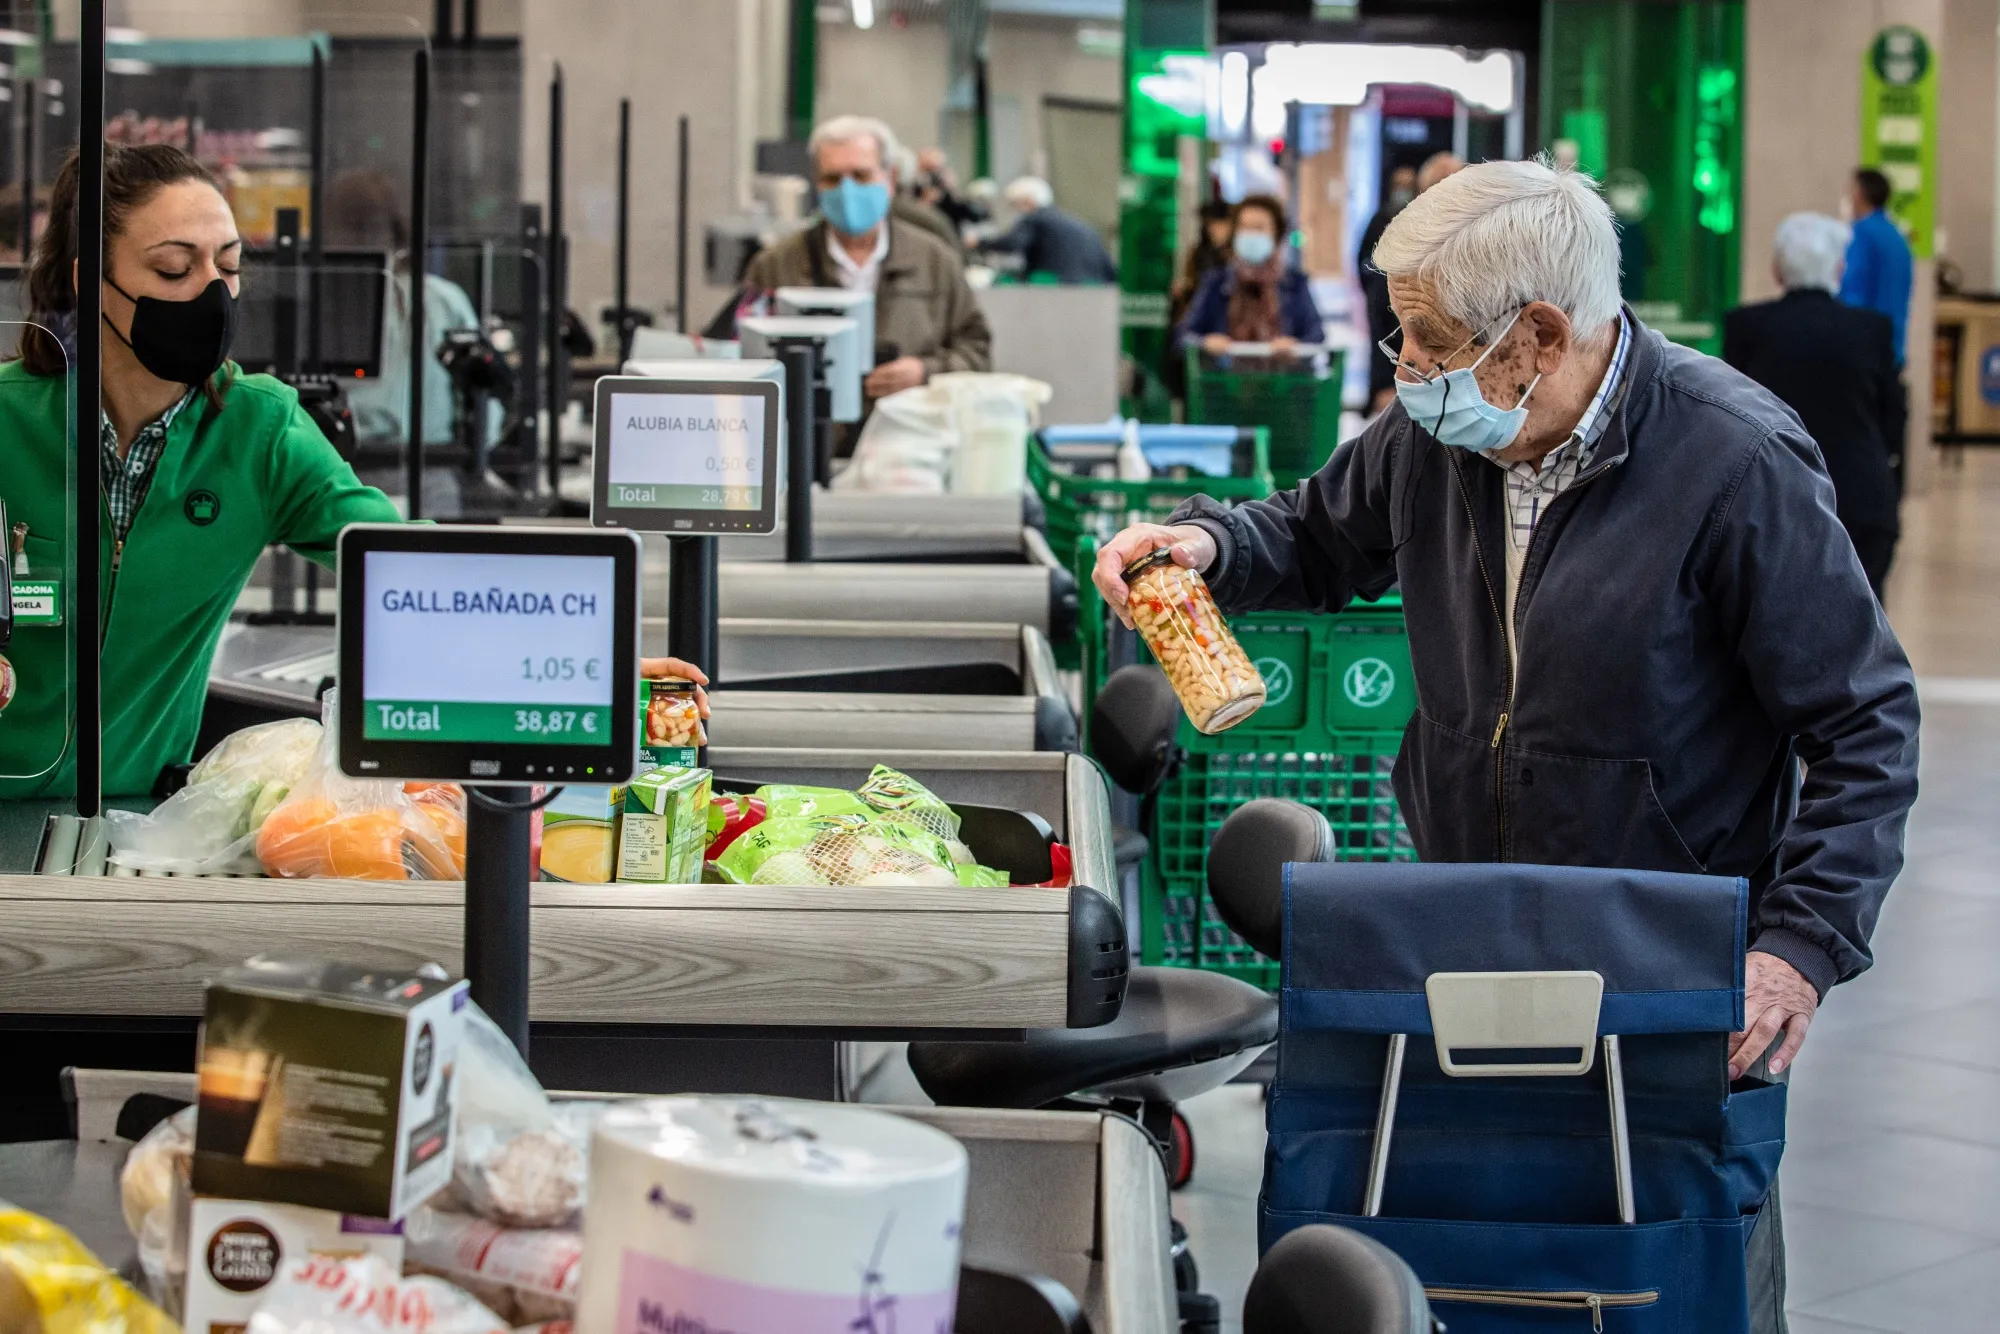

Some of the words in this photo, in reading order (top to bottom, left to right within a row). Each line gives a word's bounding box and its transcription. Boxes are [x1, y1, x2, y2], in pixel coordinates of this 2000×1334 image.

[626, 416, 683, 431] ALUBIA
[687, 417, 749, 432] BLANCA
[705, 456, 741, 473] 0,50
[745, 457, 756, 471] €
[617, 486, 656, 502] Total
[701, 489, 740, 504] 28,79
[12, 586, 54, 594] CADONA
[382, 587, 555, 615] GALL.BAÑADA
[562, 593, 596, 616] CH
[521, 656, 576, 682] 1,05
[584, 658, 600, 681] €
[377, 704, 441, 731] Total
[514, 710, 576, 735] 38,87
[581, 712, 598, 733] €
